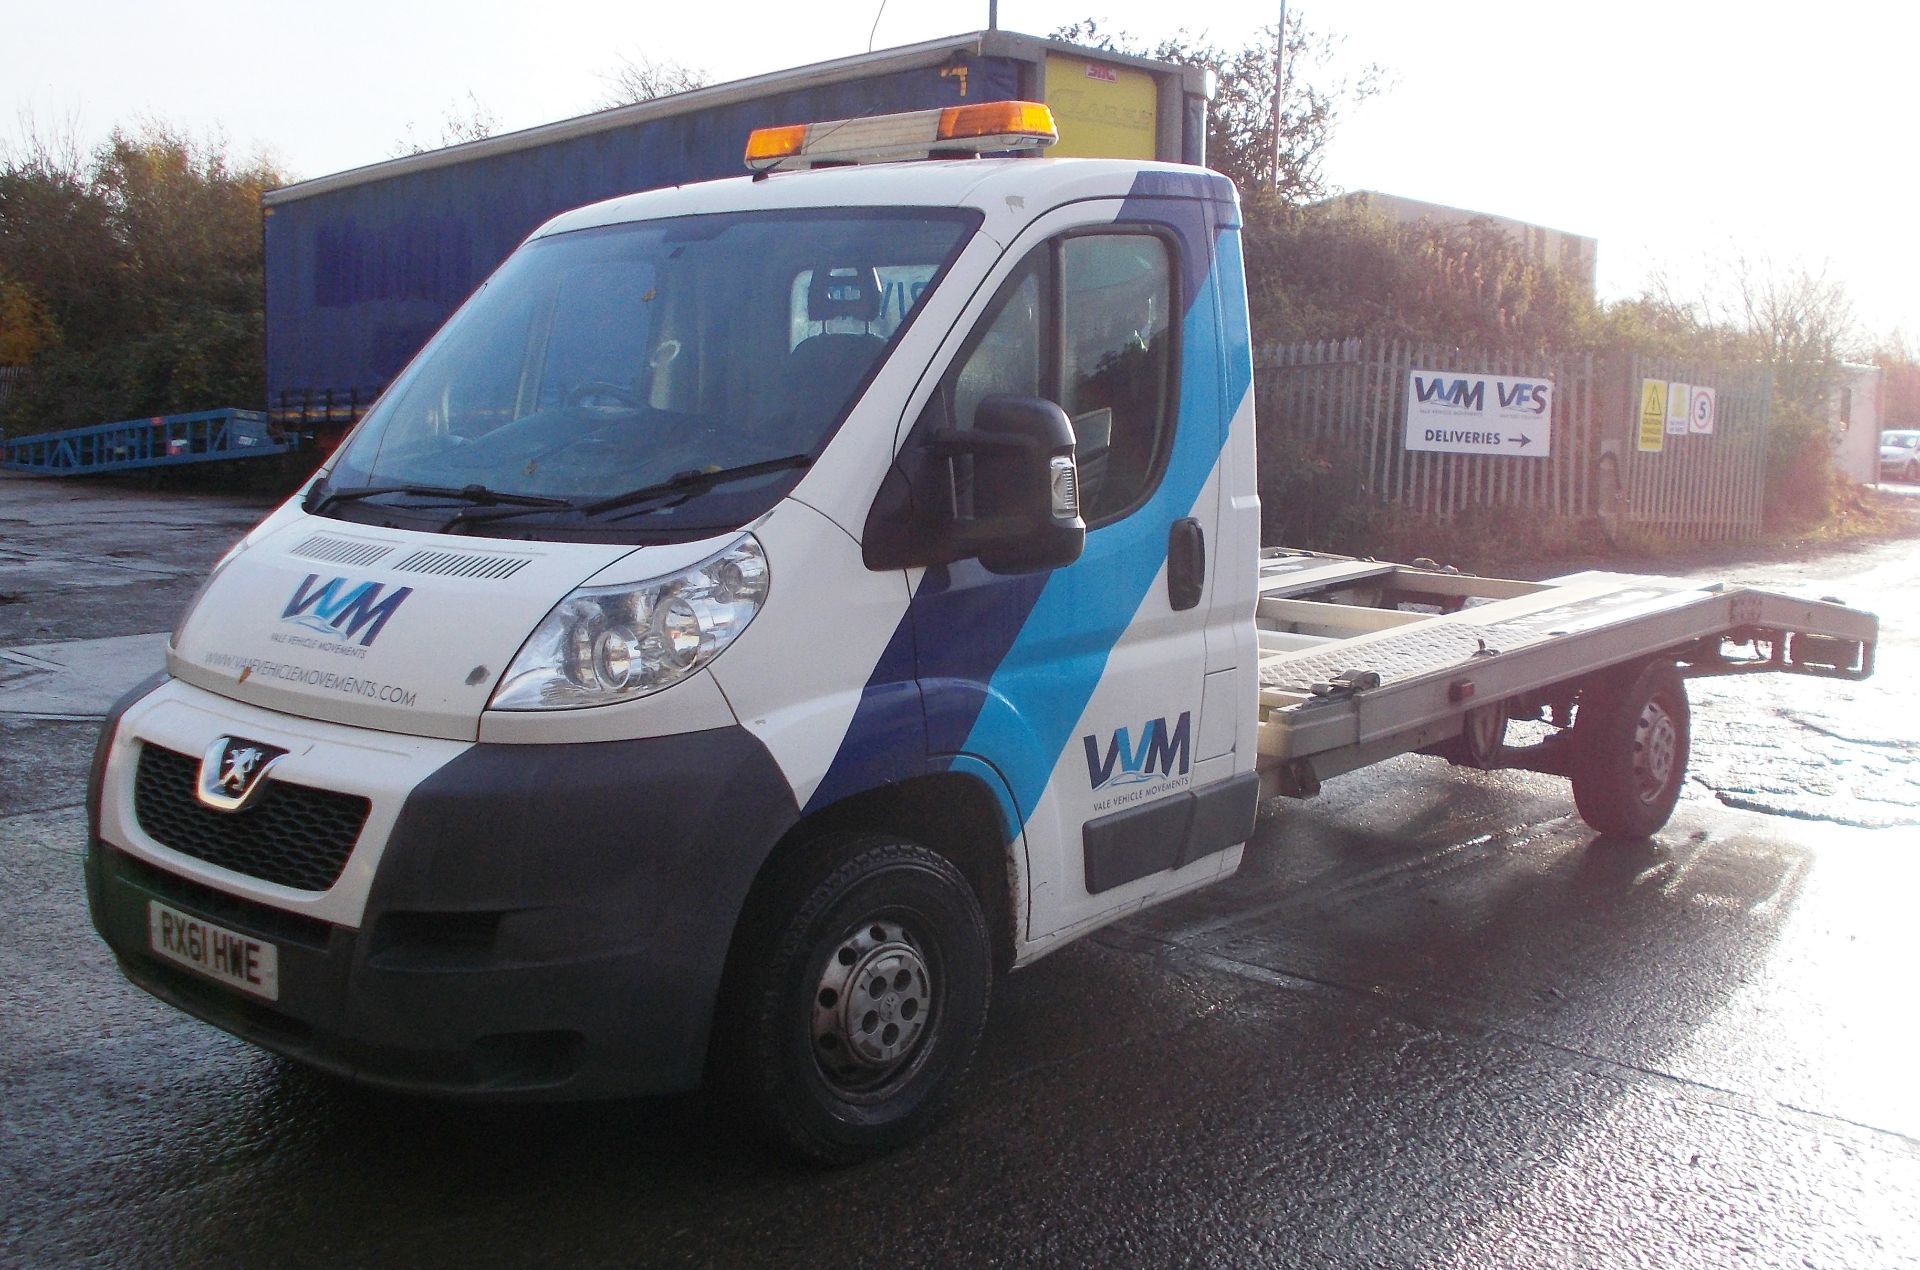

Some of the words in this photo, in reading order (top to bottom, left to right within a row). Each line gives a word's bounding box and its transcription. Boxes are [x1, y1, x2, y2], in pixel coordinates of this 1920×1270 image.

[1497, 382, 1548, 414] VFS
[1698, 401, 1707, 420] 5
[1425, 429, 1501, 445] DELIVERIES
[271, 632, 287, 644] VALE
[288, 636, 319, 649] VEHICLE
[319, 642, 367, 659] MOVEMENTS
[1093, 800, 1111, 811] VALE
[1113, 790, 1143, 806] VEHICLE
[1146, 777, 1189, 797] MOVEMENTS
[161, 911, 208, 965] RX61
[213, 931, 261, 985] HWE
